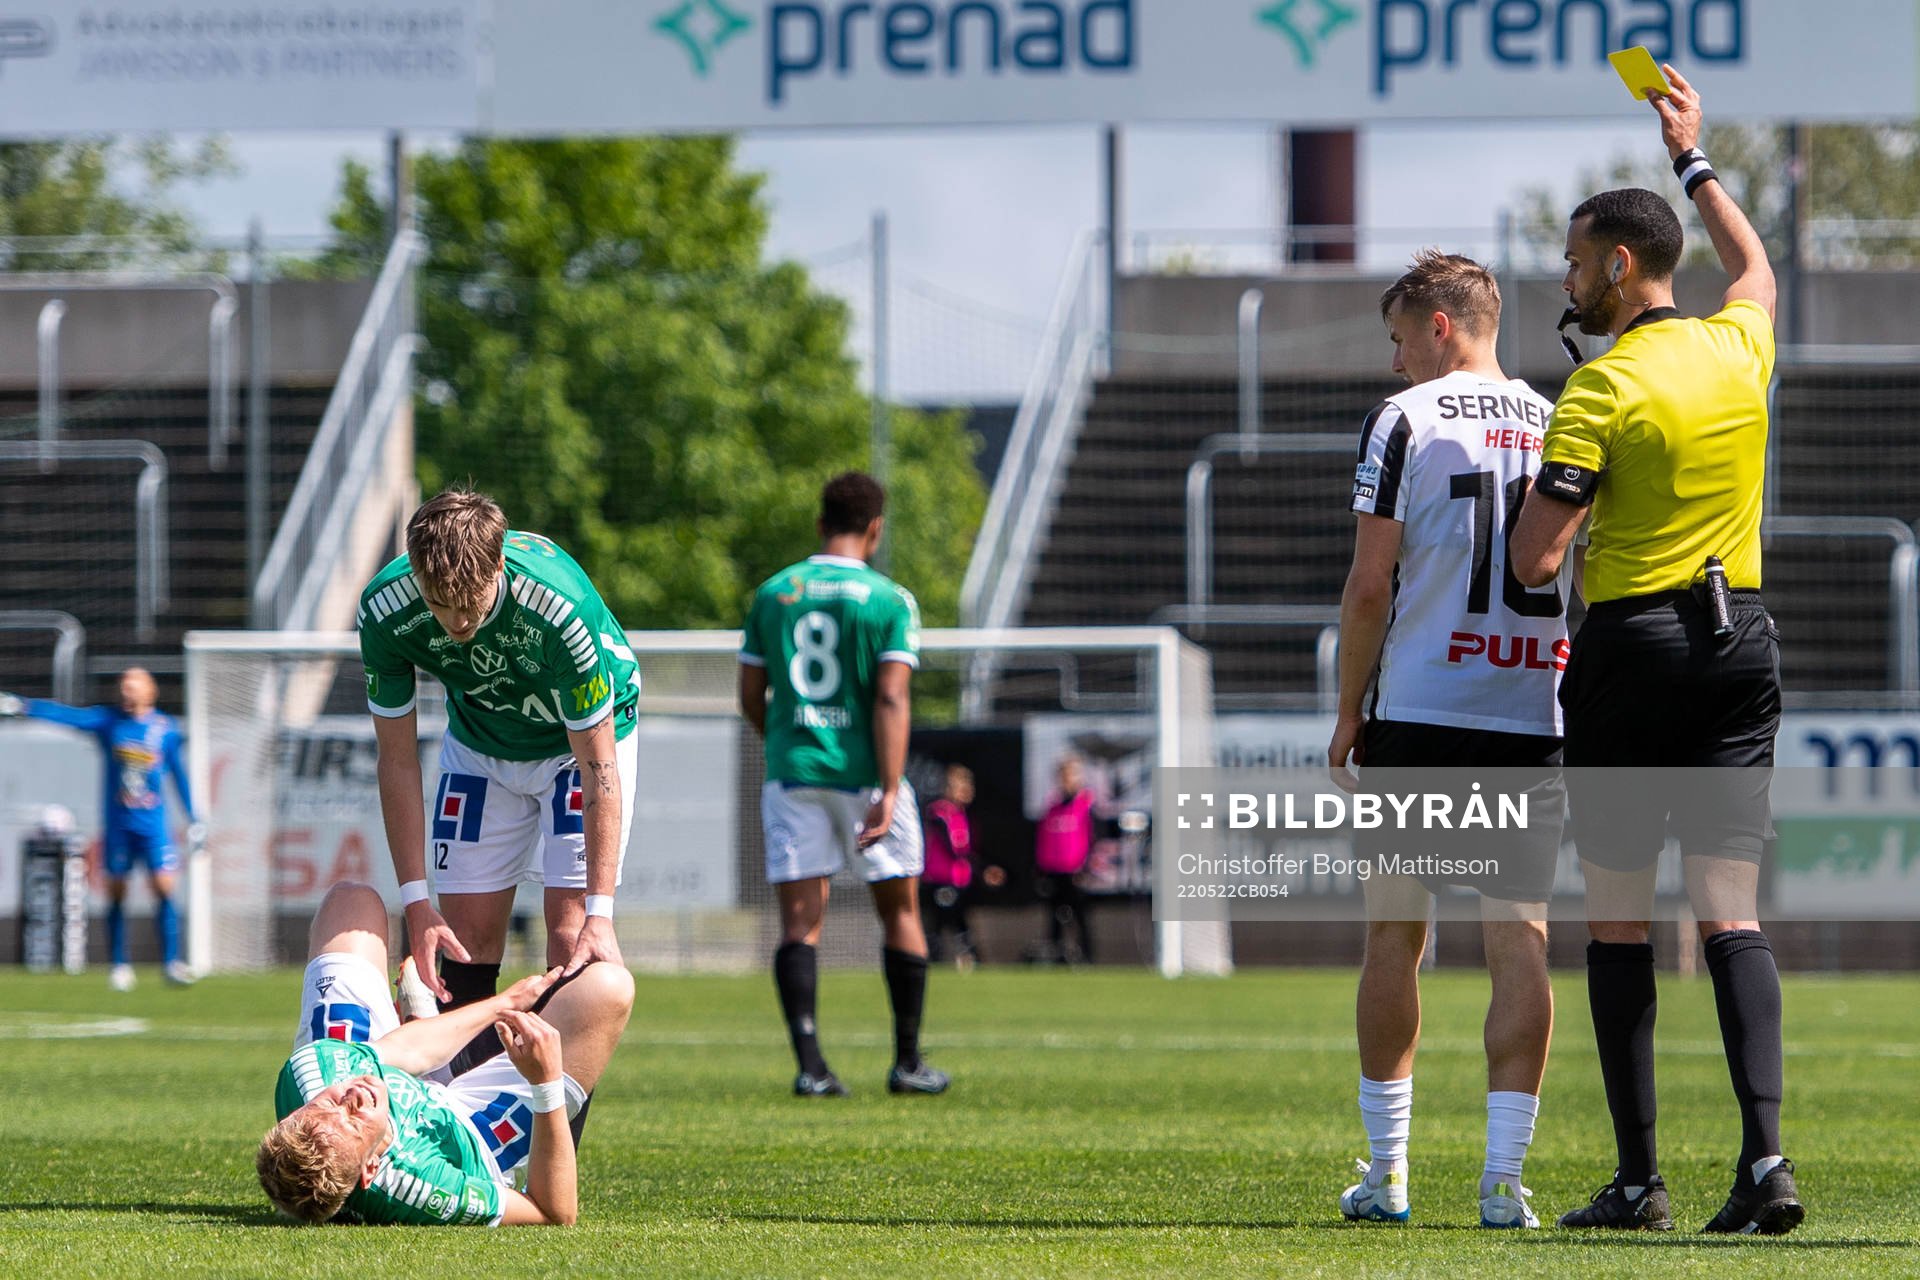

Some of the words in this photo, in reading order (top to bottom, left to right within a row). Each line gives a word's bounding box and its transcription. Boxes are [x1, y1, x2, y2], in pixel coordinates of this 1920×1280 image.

[768, 0, 1136, 104] prenad
[1371, 0, 1747, 98] prenad
[571, 673, 610, 713] XXL
[789, 610, 841, 700] 8
[435, 842, 449, 870] 12
